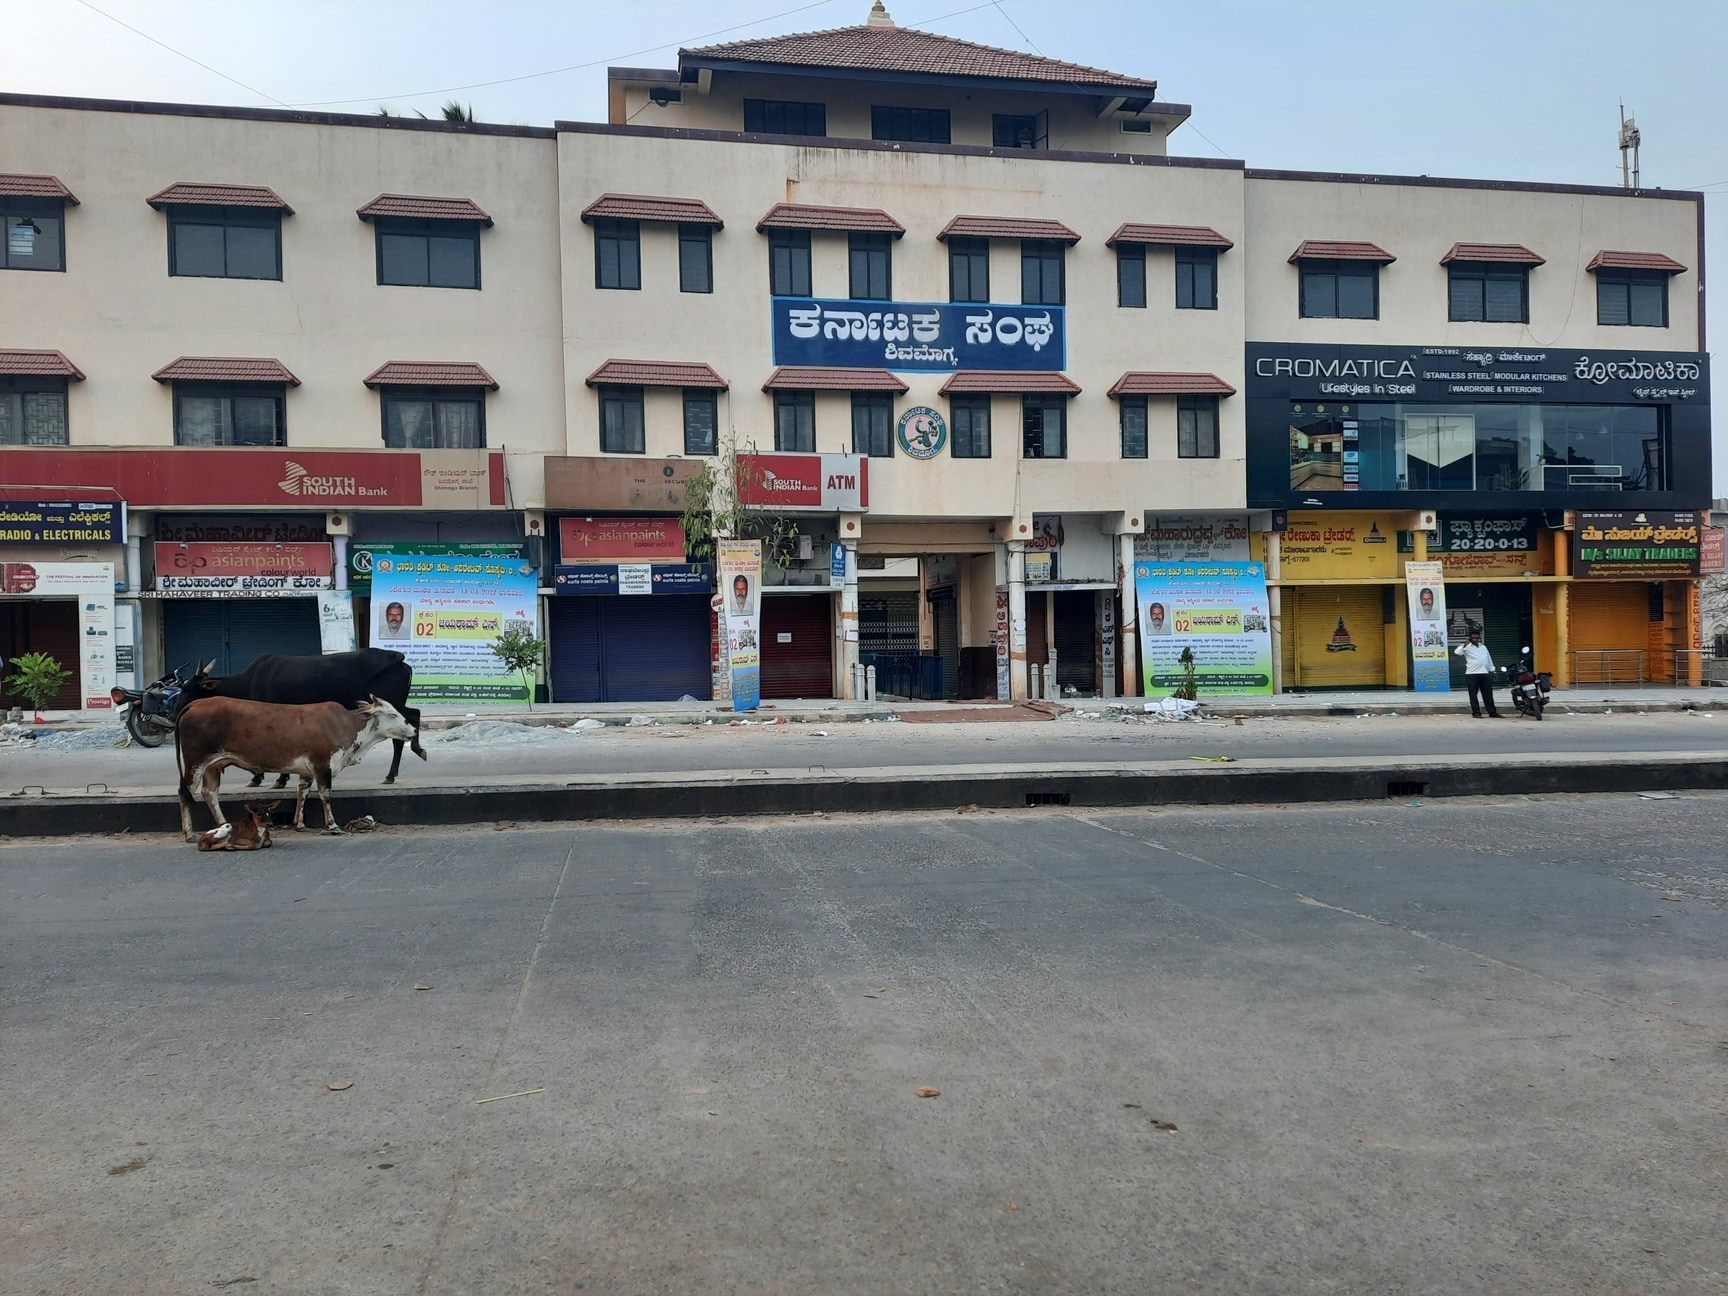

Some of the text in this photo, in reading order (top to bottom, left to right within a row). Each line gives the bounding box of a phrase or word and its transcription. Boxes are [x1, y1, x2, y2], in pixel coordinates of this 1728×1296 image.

[789, 304, 1054, 351] ಕರ್ನಾಟಕ ಸಂಘ
[1256, 358, 1416, 378] CROMATICA
[1574, 356, 1699, 384] ಕ್ರೋಮಾಟಿಕಾ
[1425, 371, 1465, 379] STAINLESS
[1532, 373, 1567, 381] KITCHENS
[1320, 383, 1370, 396] Lifestyles
[1388, 384, 1416, 394] Steel
[1452, 385, 1495, 393] WARDROBE
[303, 477, 355, 486] SOUTH
[827, 475, 855, 489] ATM
[303, 486, 387, 496] INDIAN Bank
[0, 530, 31, 540] RADIO
[43, 530, 111, 540] ELECTRICALS
[599, 529, 666, 544] asianpaints
[1287, 528, 1320, 541] ರೇಣುಕಾ
[1605, 526, 1653, 540] ಸುಜಯ್
[1581, 548, 1697, 561] M/s SUJAY TRADERS
[212, 554, 304, 571] asianpaints
[178, 576, 238, 588] ಮಹಾವೀರ್
[416, 622, 434, 636] 02
[1175, 620, 1190, 632] 02
[729, 639, 738, 650] 02
[1414, 637, 1423, 647] 02
